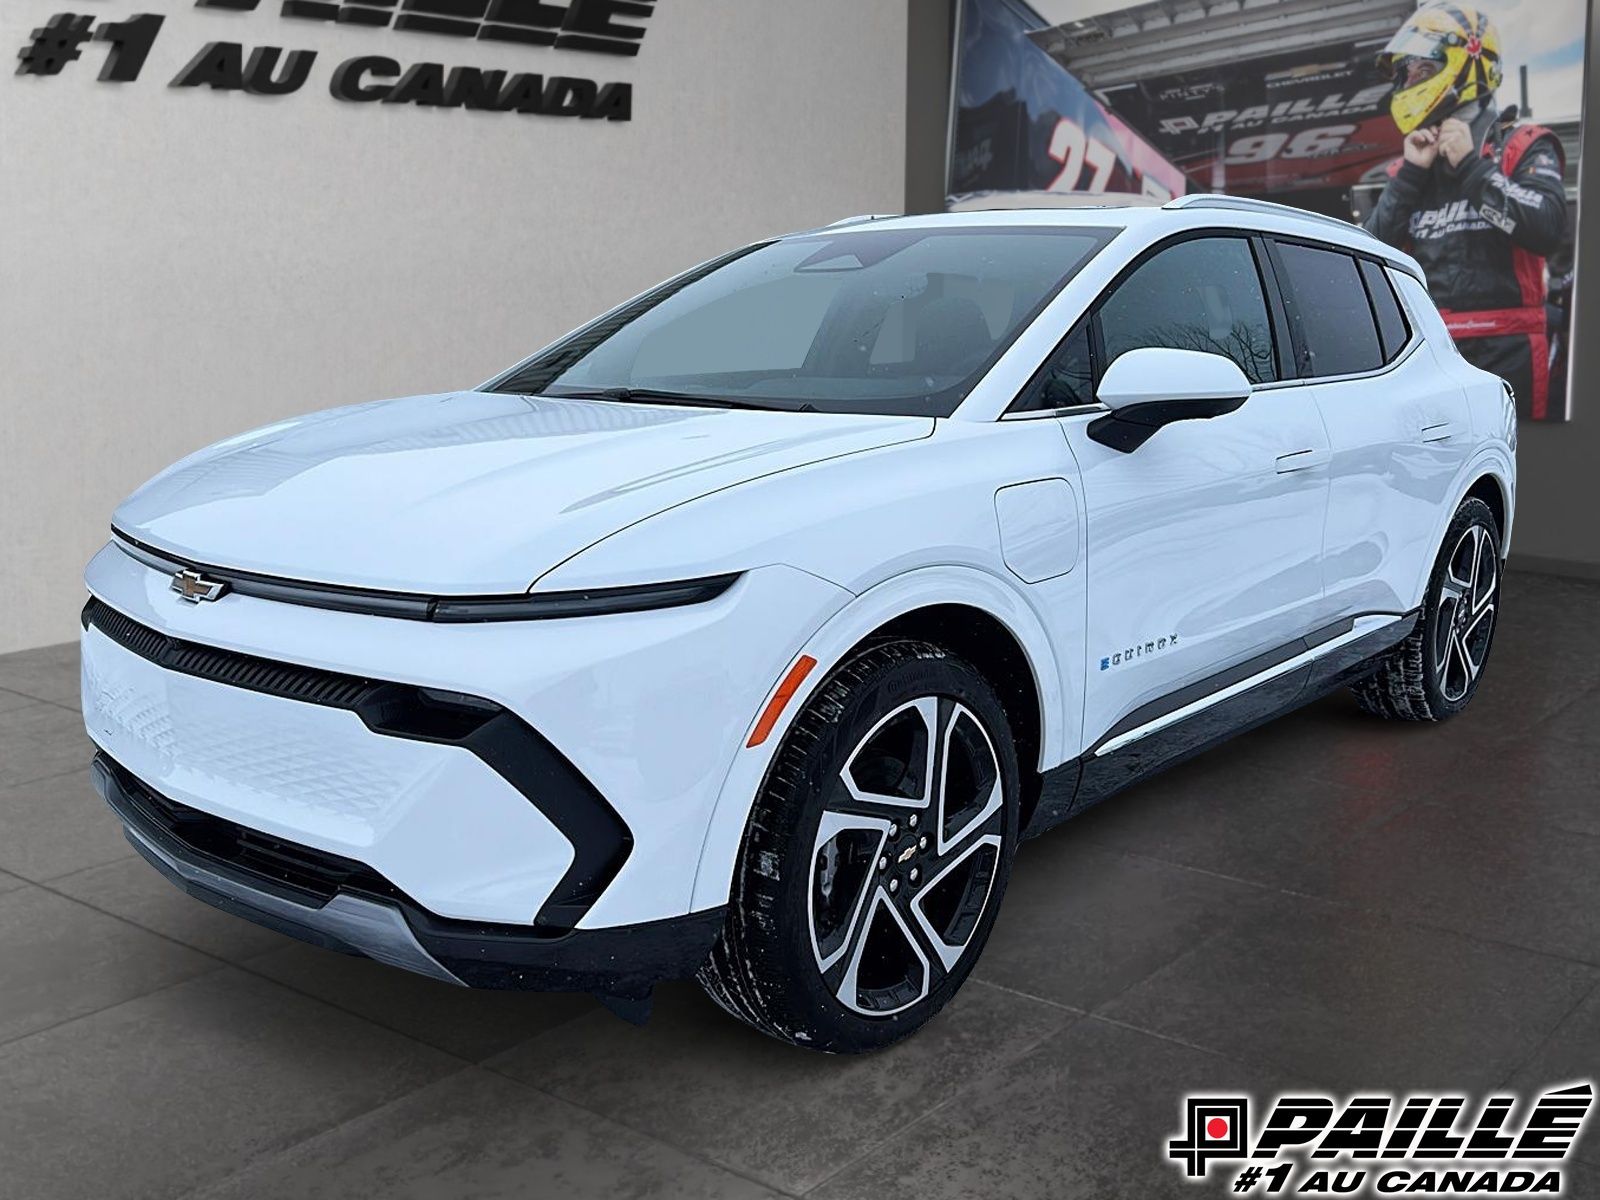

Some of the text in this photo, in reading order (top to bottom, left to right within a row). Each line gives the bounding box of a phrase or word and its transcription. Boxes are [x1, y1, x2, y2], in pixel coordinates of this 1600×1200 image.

[14, 13, 165, 82] #1
[168, 41, 317, 95] AU
[329, 55, 633, 121] CANADA
[1230, 119, 1264, 131] AU
[1271, 104, 1378, 124] CANADA
[1048, 118, 1117, 192] 27
[1223, 124, 1356, 165] 96
[1100, 633, 1178, 671] EQUINOX
